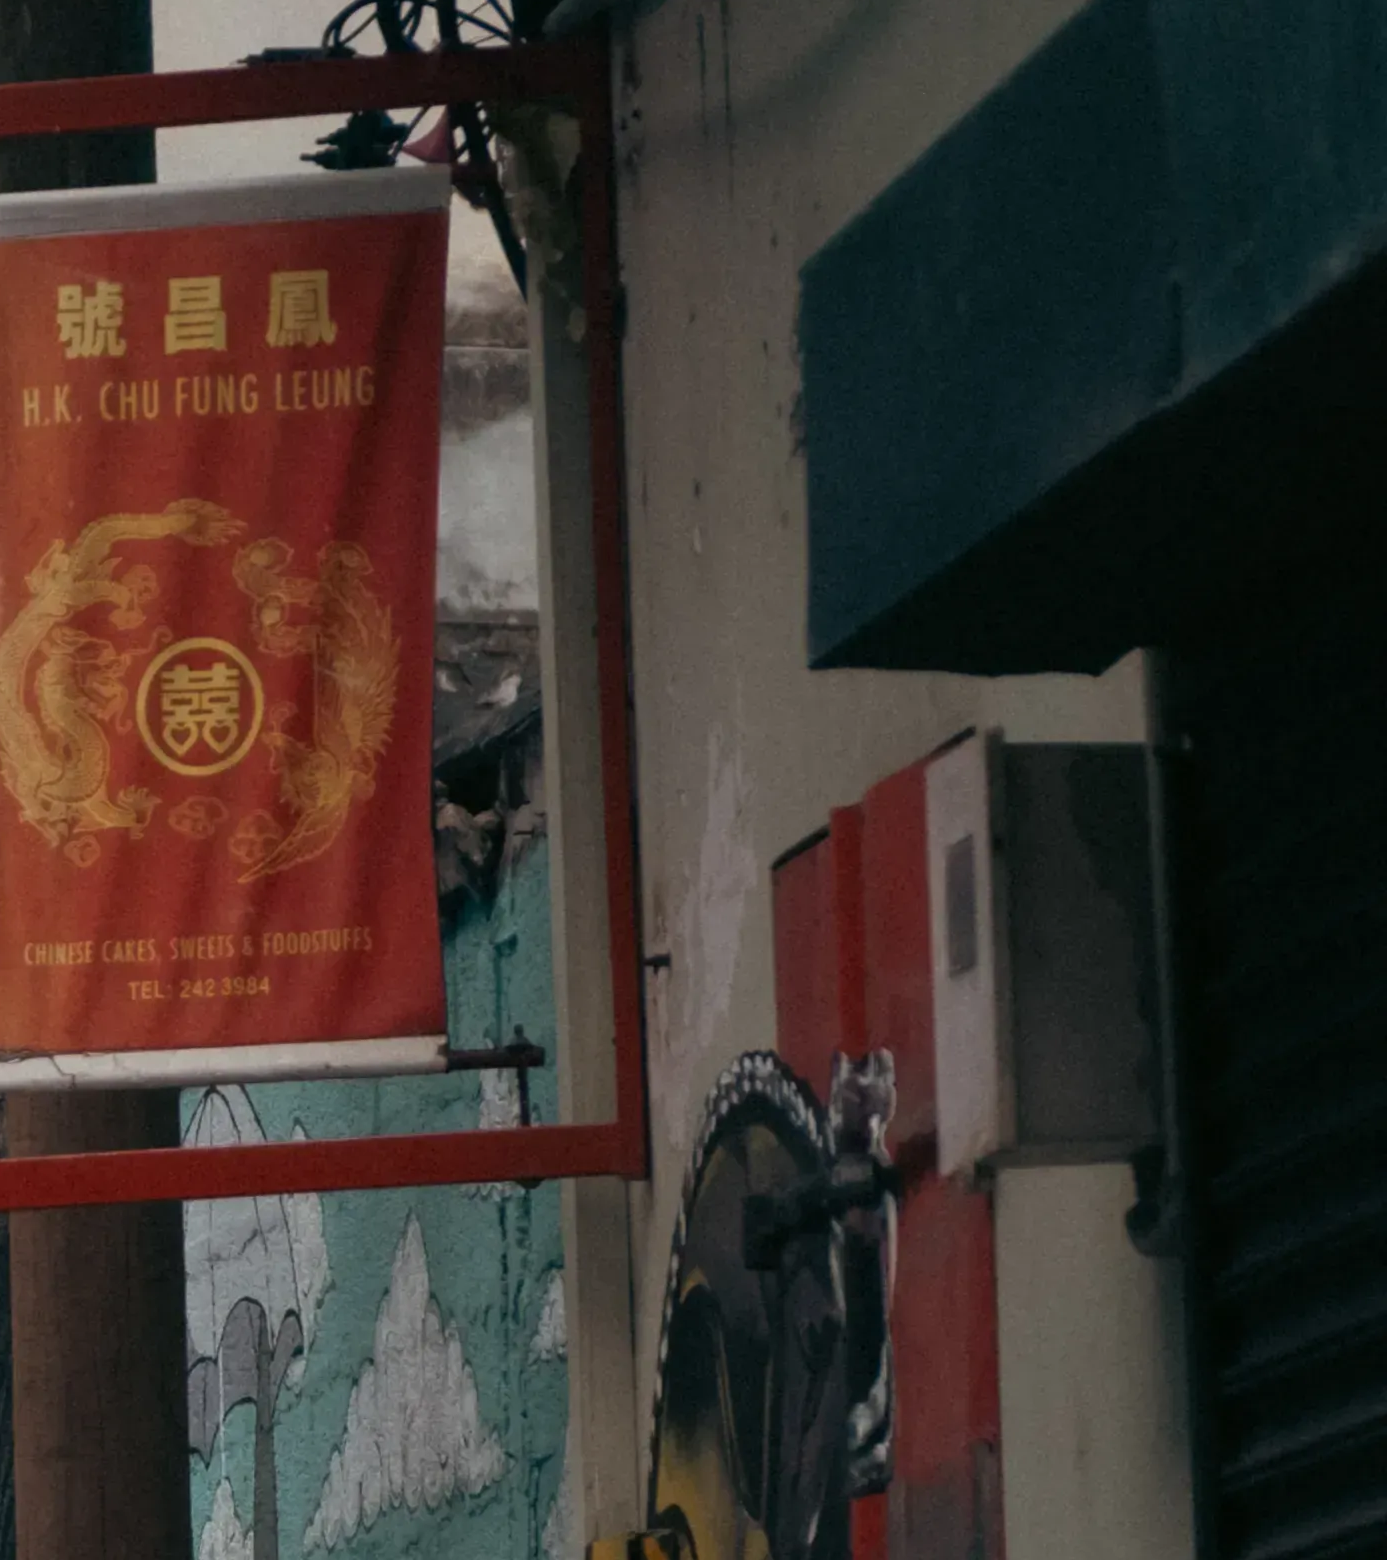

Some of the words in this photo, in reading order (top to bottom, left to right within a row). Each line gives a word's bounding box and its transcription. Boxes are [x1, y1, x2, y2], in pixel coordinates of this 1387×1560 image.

[23, 384, 82, 428] H.K.
[99, 377, 160, 421] CHU
[174, 372, 258, 418] FUNG
[275, 364, 375, 411] LEUNG
[23, 941, 94, 966] CHINESE
[171, 934, 236, 960] SWEETS
[241, 935, 255, 956] &
[262, 926, 373, 956] FOODSTUFFS
[179, 978, 216, 999] 242
[220, 975, 271, 997] 3984
